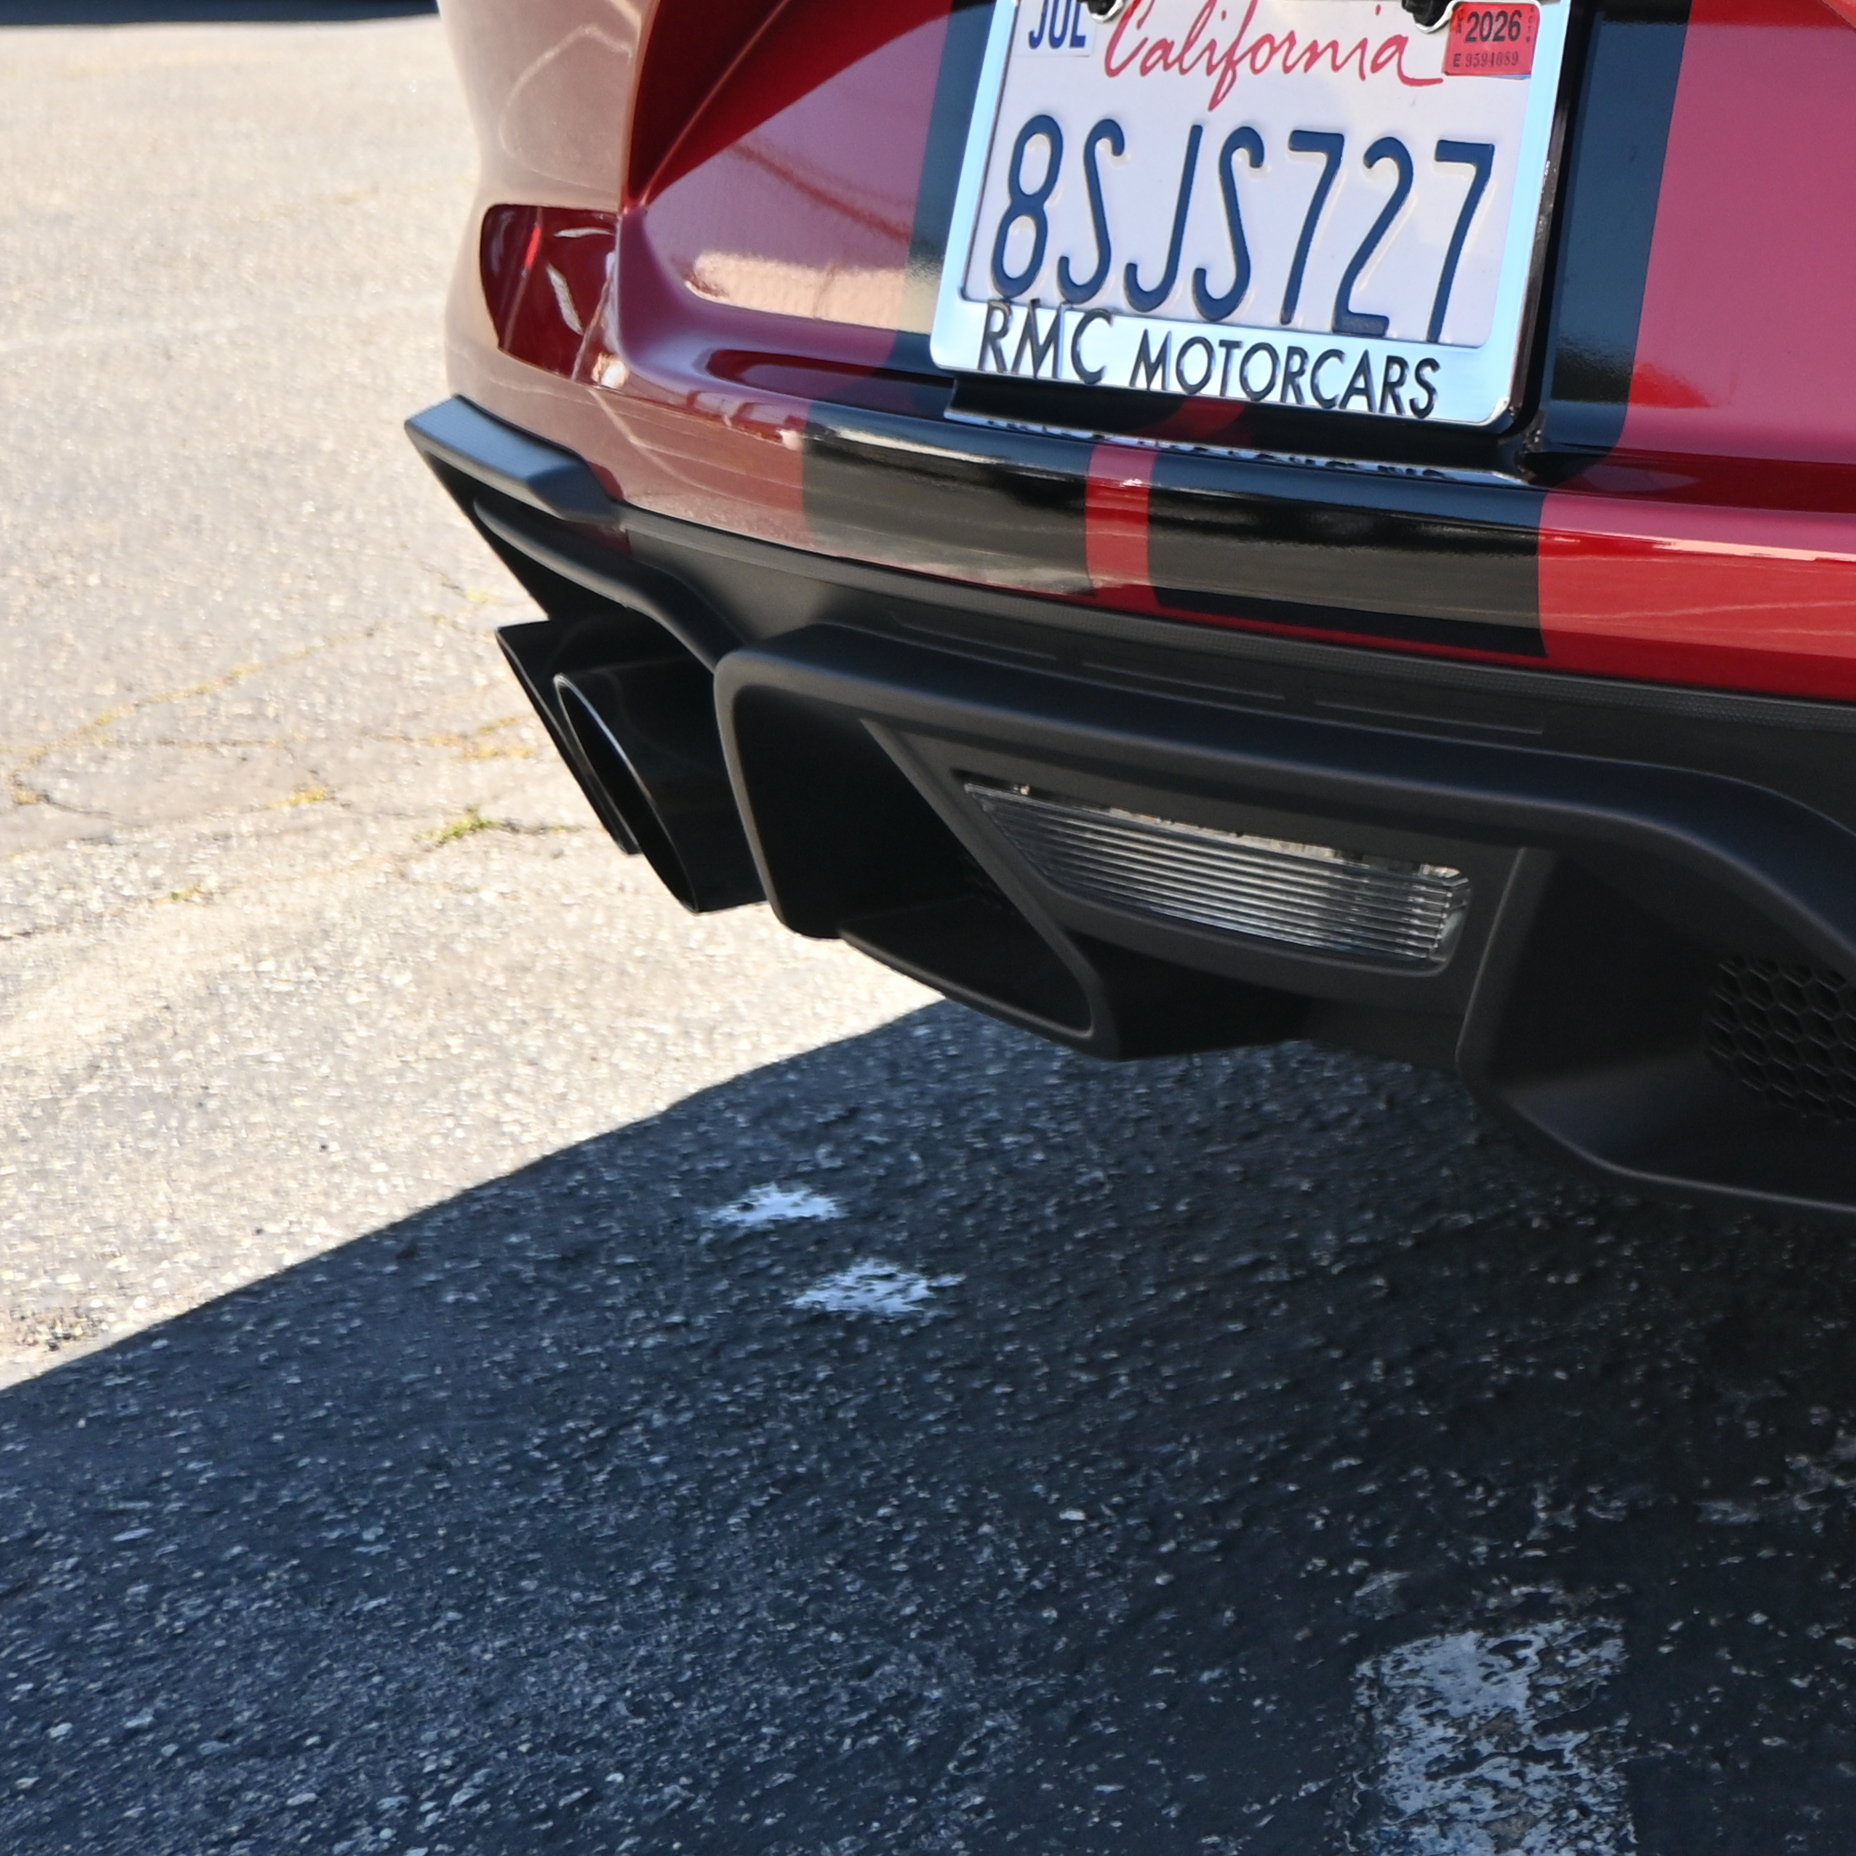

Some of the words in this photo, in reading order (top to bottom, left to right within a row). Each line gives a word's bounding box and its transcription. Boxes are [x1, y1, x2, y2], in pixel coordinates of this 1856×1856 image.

[1465, 10, 1523, 42] 2026
[990, 114, 1496, 343] 8SJS727
[978, 298, 1114, 385] RMC
[1128, 328, 1441, 419] MOTORCARS
